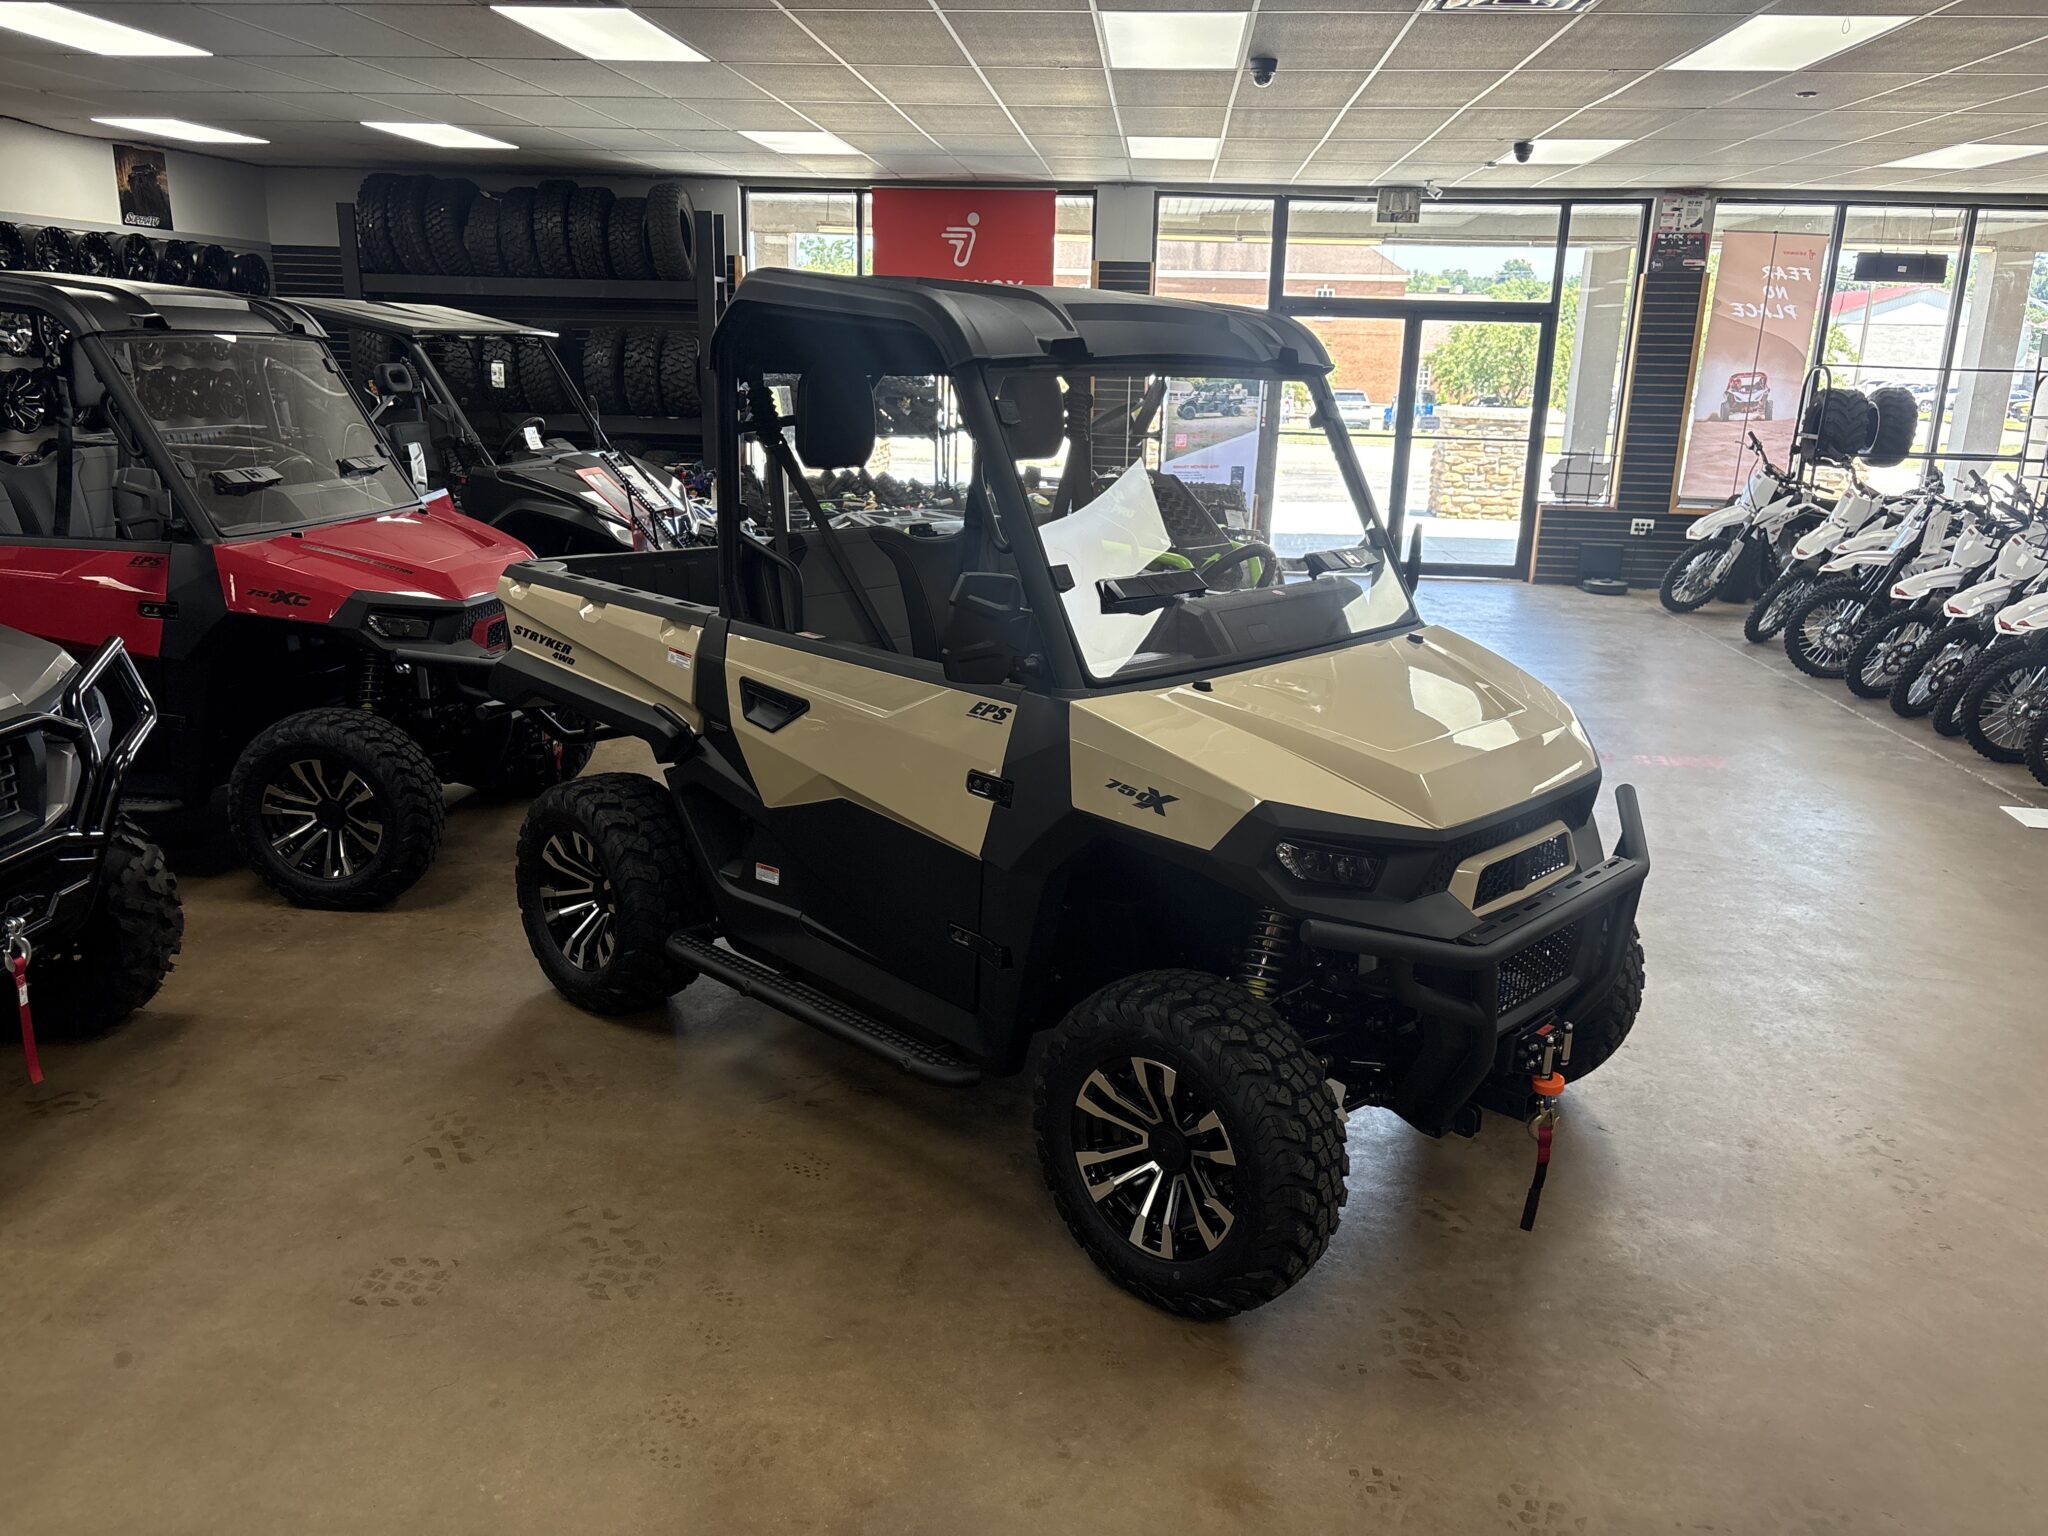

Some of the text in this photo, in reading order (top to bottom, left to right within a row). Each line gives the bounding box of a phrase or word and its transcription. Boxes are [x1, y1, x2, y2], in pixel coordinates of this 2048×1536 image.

[129, 555, 163, 567] EPS
[246, 588, 312, 607] 750XC
[513, 624, 573, 655] STRYKER
[552, 651, 576, 666] 4WD
[968, 701, 1013, 721] EPS
[1104, 778, 1181, 817] 750X
